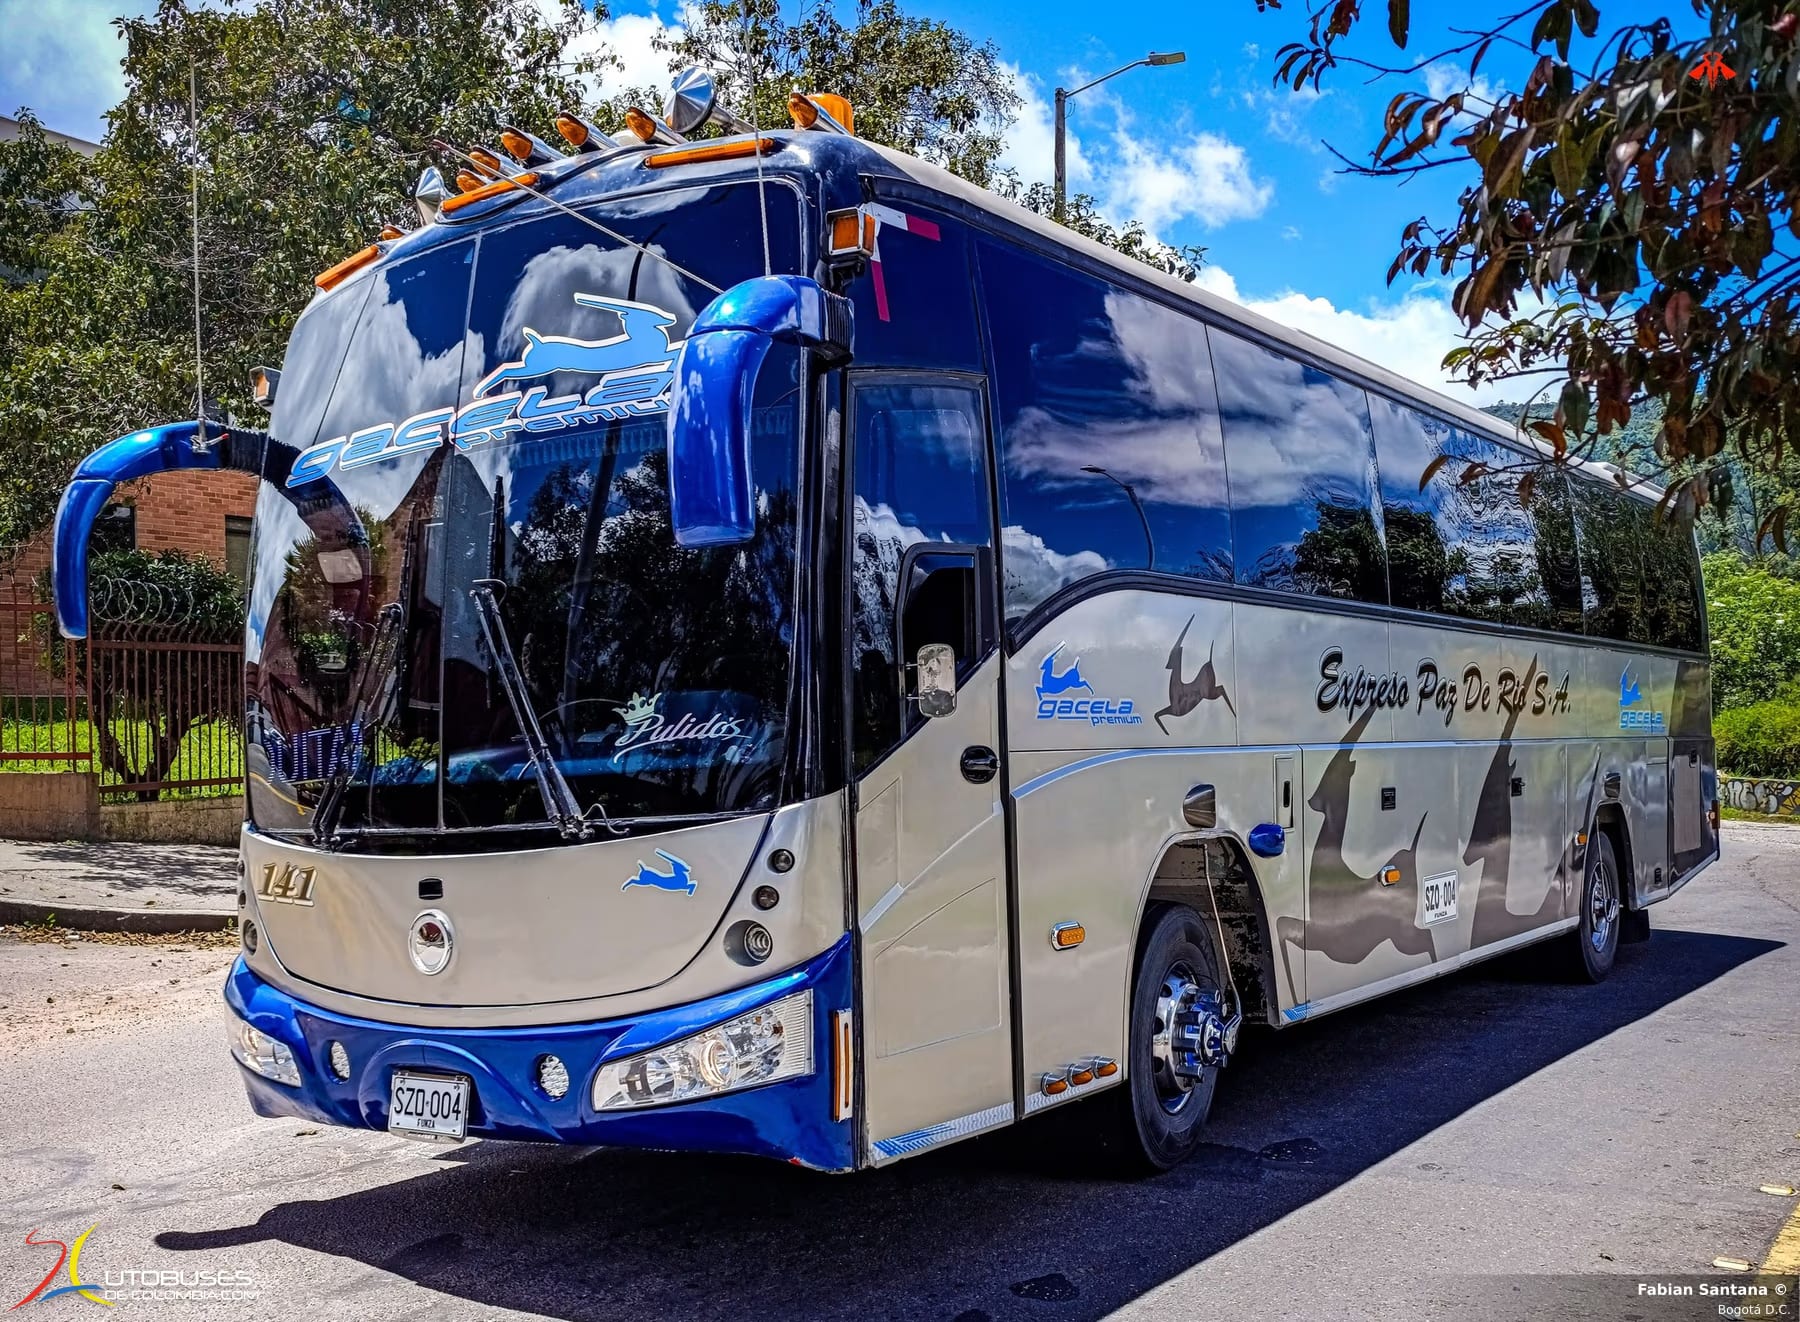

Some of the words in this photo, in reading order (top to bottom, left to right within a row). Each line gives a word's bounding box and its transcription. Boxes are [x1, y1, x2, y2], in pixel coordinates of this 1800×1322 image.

[450, 395, 672, 451] premiu
[1416, 657, 1457, 728] Paz
[1463, 661, 1491, 713] De
[257, 861, 318, 907] 141
